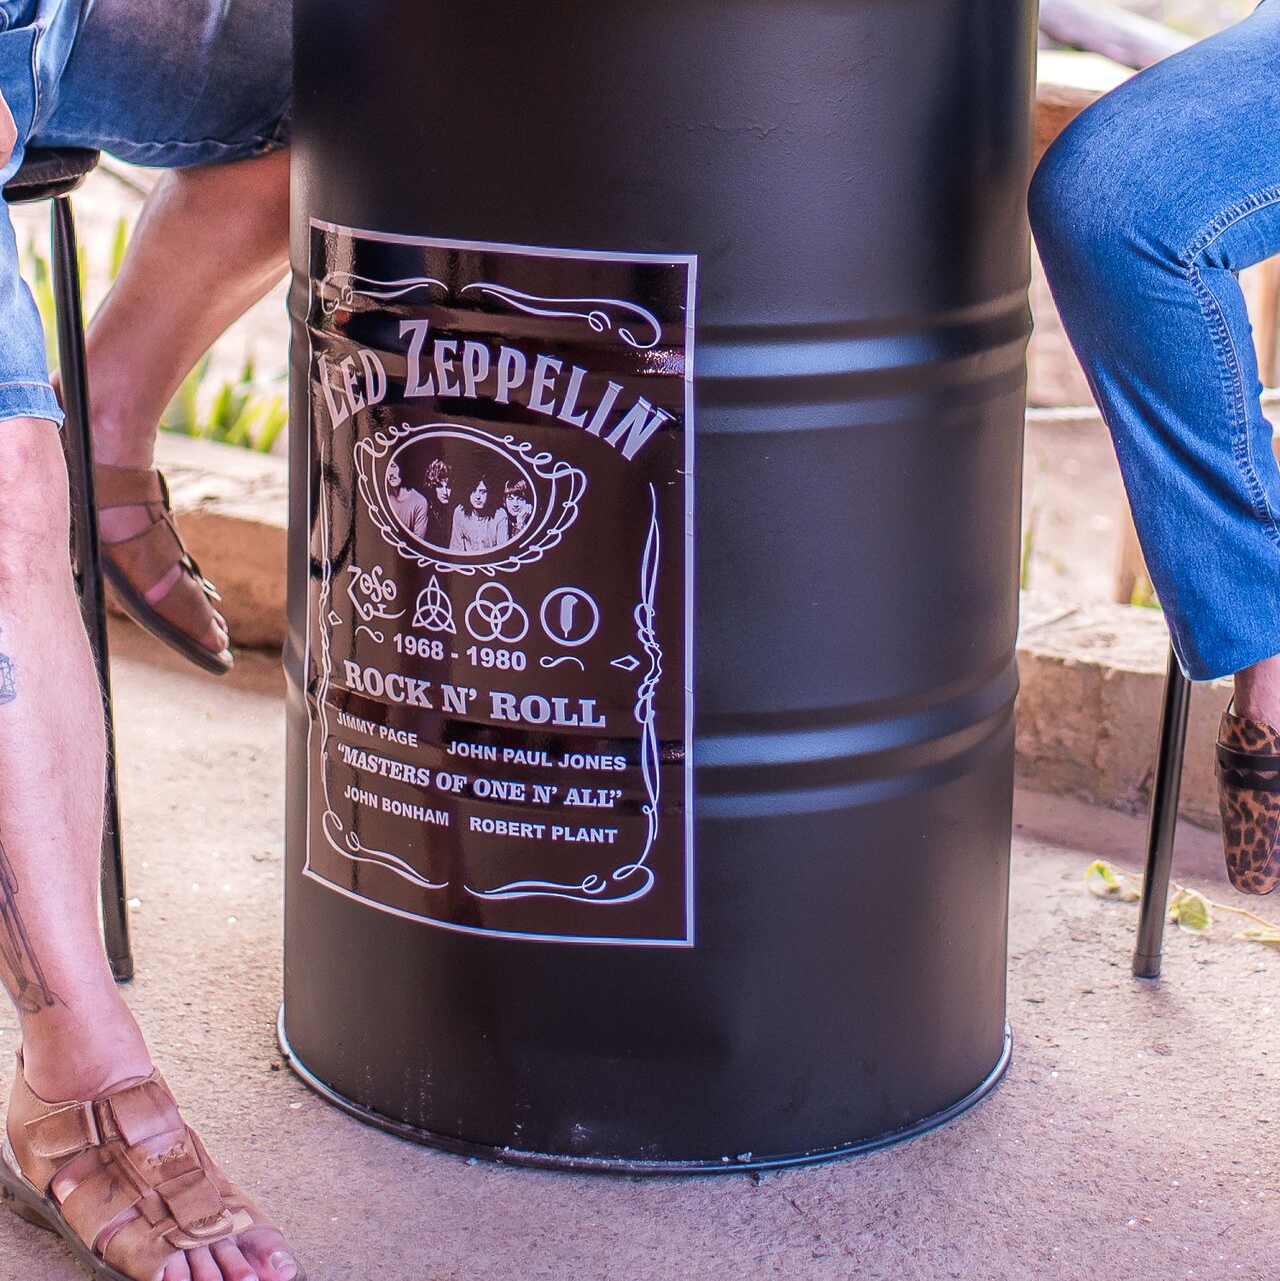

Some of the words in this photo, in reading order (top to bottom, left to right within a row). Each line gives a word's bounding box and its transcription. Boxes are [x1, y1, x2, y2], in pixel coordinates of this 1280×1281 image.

[319, 349, 388, 431] LED
[398, 319, 669, 461] ZEPPELIN
[393, 633, 444, 660] 1968
[466, 646, 527, 671] 1980
[343, 659, 433, 709] ROCK
[441, 684, 477, 714] N’
[489, 691, 606, 728] ROLL
[336, 712, 376, 736] JIMMY
[380, 726, 418, 748] PAGE
[447, 741, 497, 761] JOHN
[503, 748, 553, 767] PAUL
[558, 753, 627, 770] JONES
[337, 743, 430, 787] “MASTERS
[435, 772, 467, 793] OF
[473, 778, 526, 802] ONE
[532, 784, 557, 804] N’
[563, 788, 622, 808] ALL”
[344, 785, 378, 808] JOHN
[382, 797, 449, 826] BONHAM
[470, 817, 545, 839] ROBERT
[551, 825, 618, 844] PLANT
